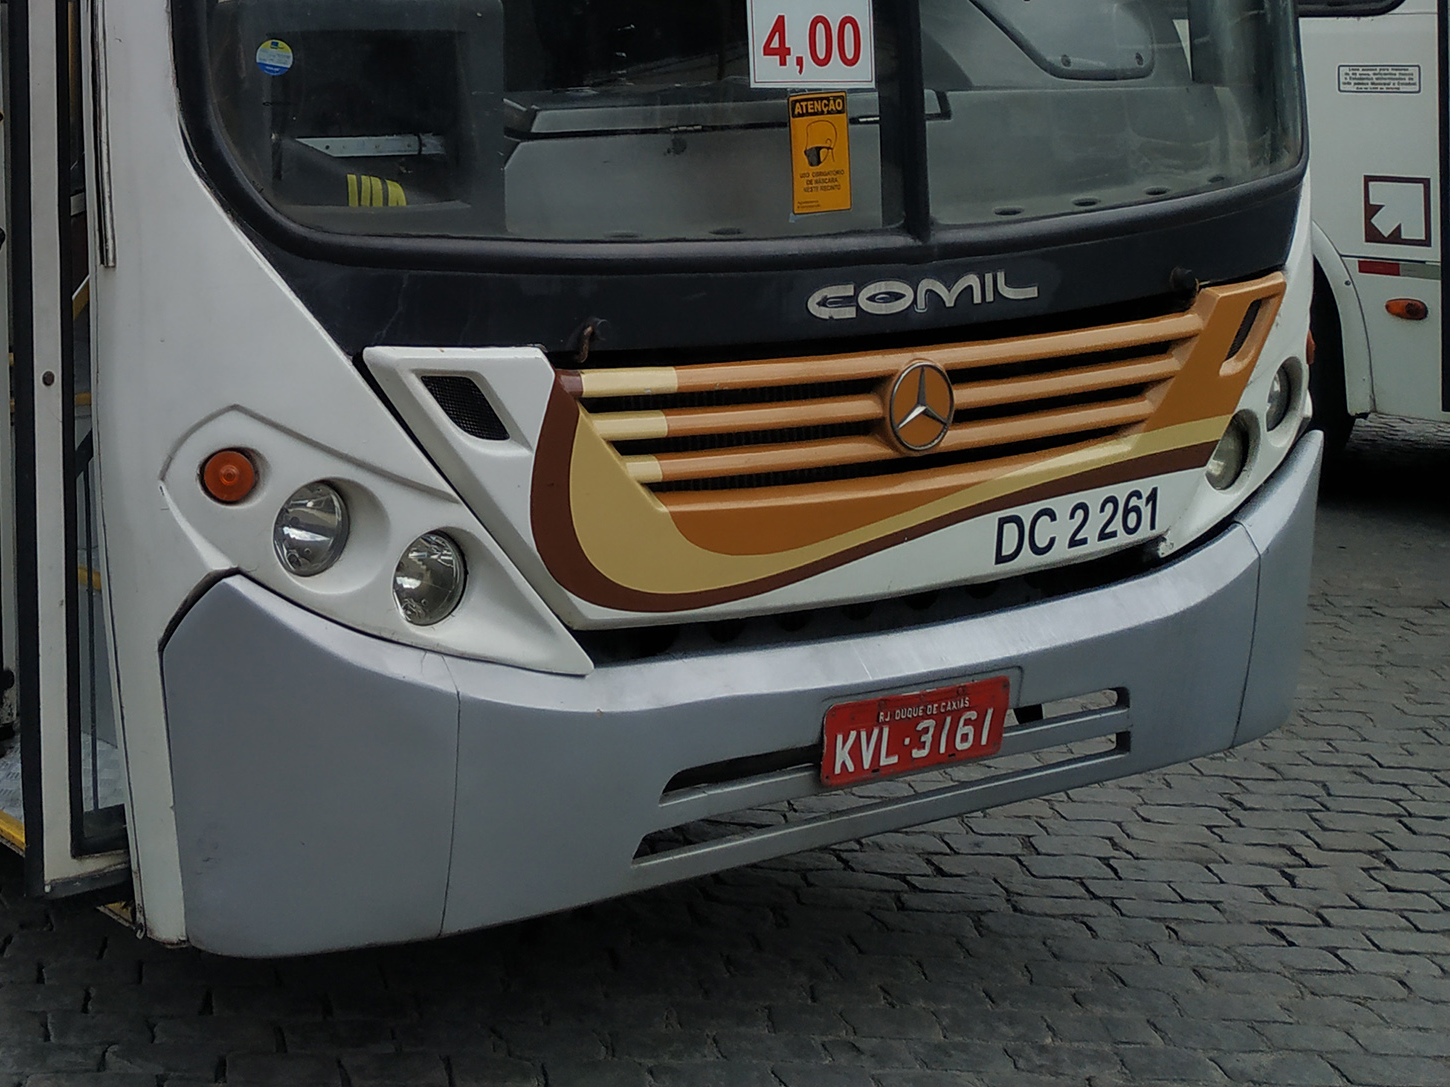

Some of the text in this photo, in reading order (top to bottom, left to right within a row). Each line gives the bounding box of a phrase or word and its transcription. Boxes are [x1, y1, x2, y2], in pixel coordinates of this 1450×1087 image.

[763, 15, 862, 75] 4,00
[794, 97, 843, 114] ATENÇÃO
[806, 270, 1039, 320] COMIL
[994, 507, 1057, 566] DC
[878, 696, 970, 723] RJ DUQUE DE CAXIAS
